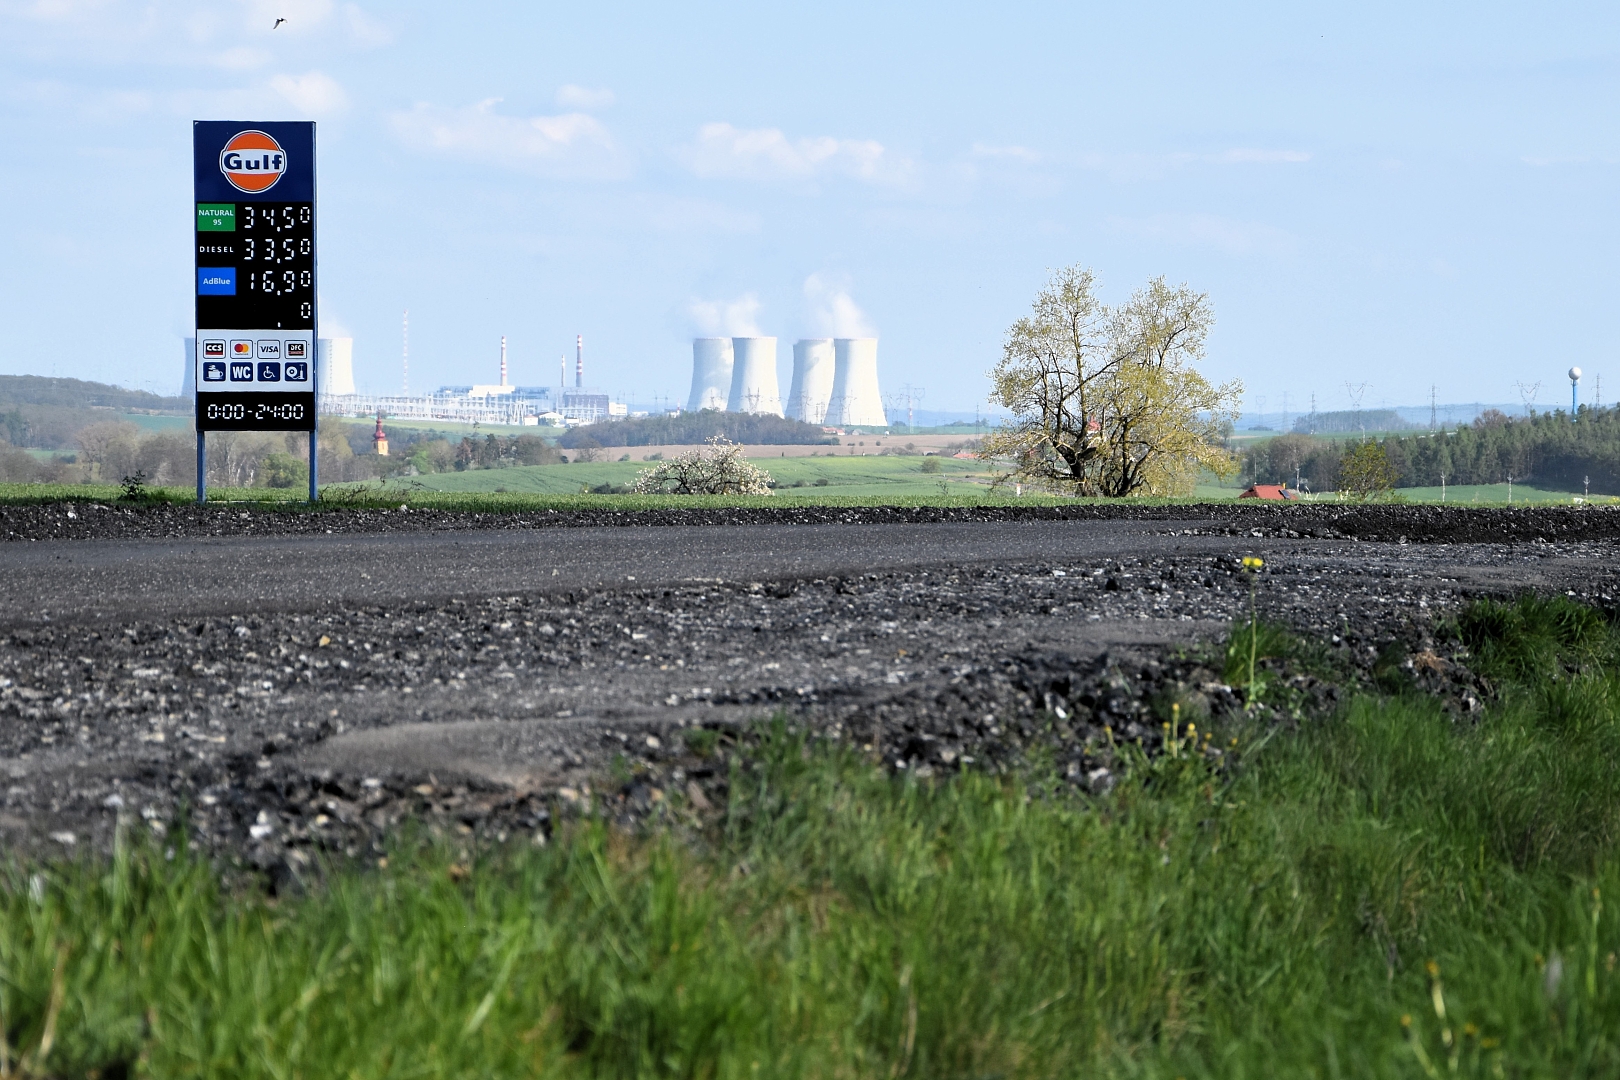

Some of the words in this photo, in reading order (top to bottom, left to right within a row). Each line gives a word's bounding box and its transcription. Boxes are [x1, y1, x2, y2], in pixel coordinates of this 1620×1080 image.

[224, 153, 283, 170] Gulf
[244, 206, 311, 232] 34,50
[244, 238, 311, 264] 33,50
[203, 277, 231, 285] AdBlue
[250, 270, 311, 296] 16,90
[232, 366, 251, 379] WC
